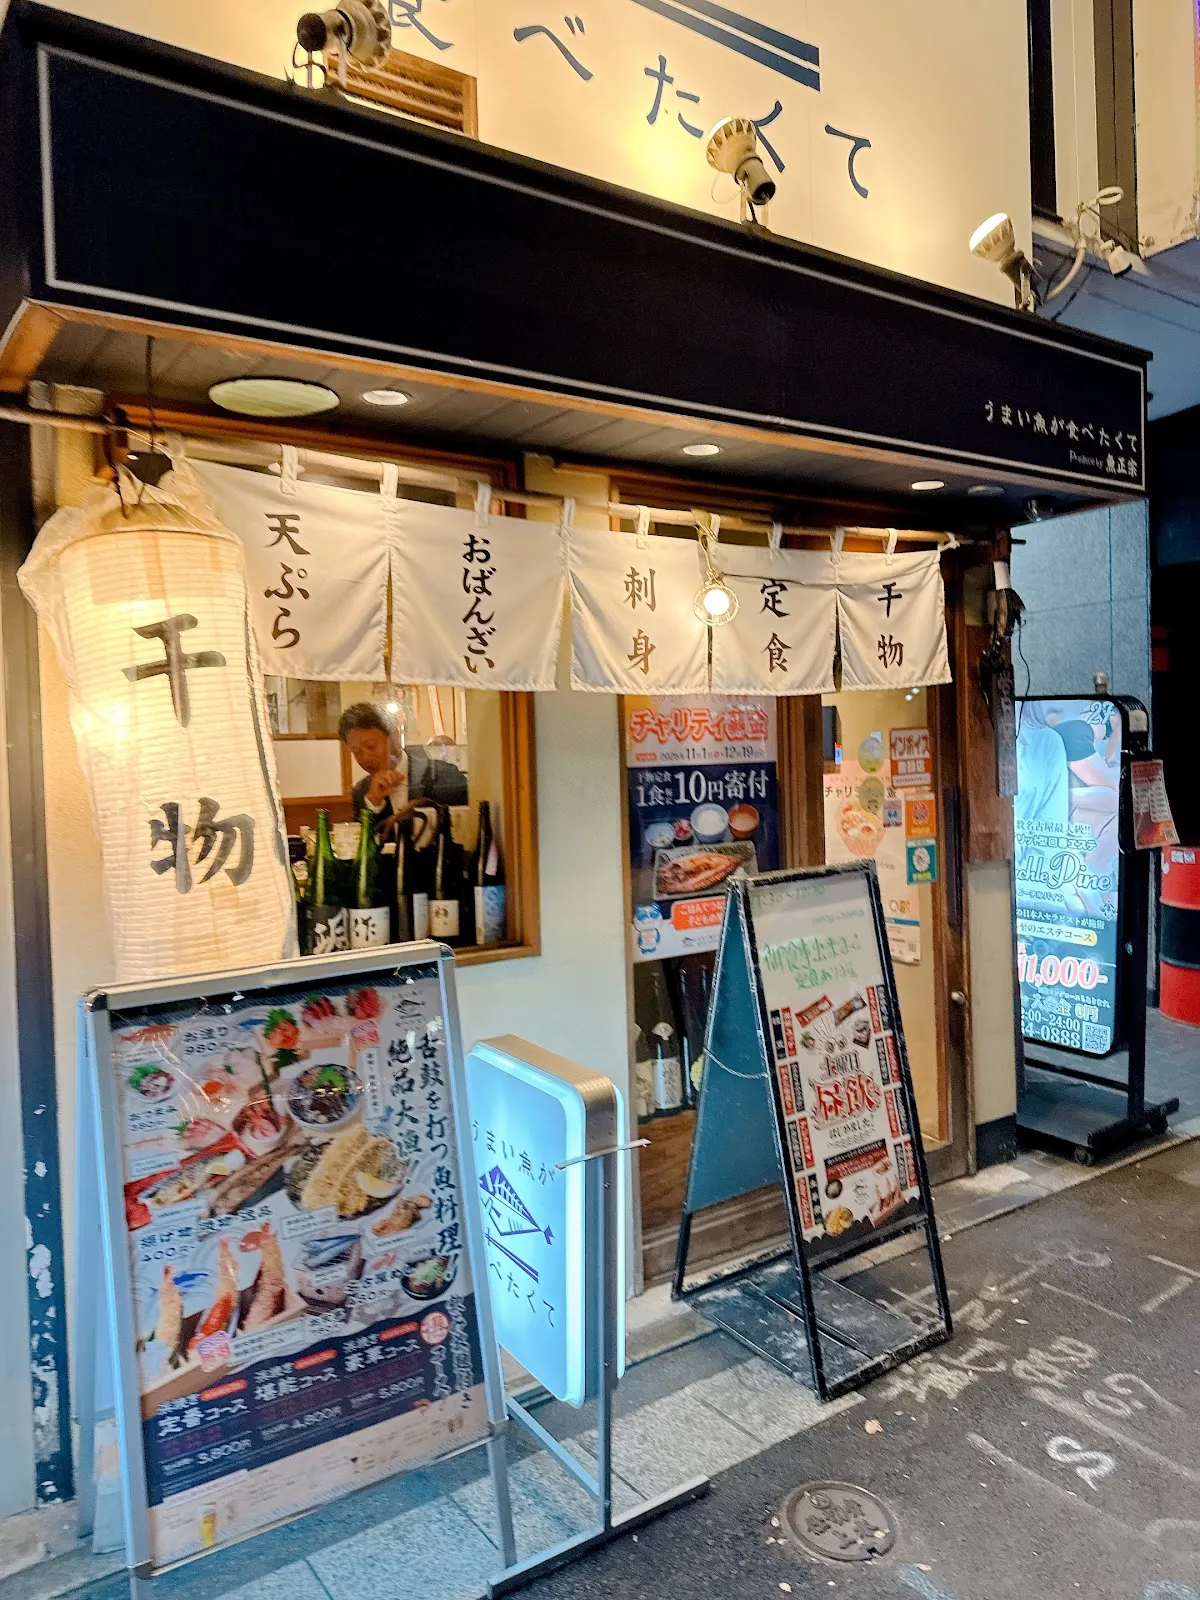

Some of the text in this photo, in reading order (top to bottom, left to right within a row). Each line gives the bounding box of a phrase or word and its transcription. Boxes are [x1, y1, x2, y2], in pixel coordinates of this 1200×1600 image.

[985, 400, 1138, 453] うまい魚が食べたくて
[1106, 453, 1138, 478] 魚正宗
[264, 513, 311, 649] 天ぷら
[462, 533, 497, 674] おばんざい
[623, 566, 656, 674] 刺身
[760, 579, 791, 673] 定食
[877, 582, 904, 669] 干物
[122, 613, 256, 894] 干物
[674, 769, 769, 804] 10円寄付
[416, 1033, 463, 1282] 舌鼓を打つ魚料理!
